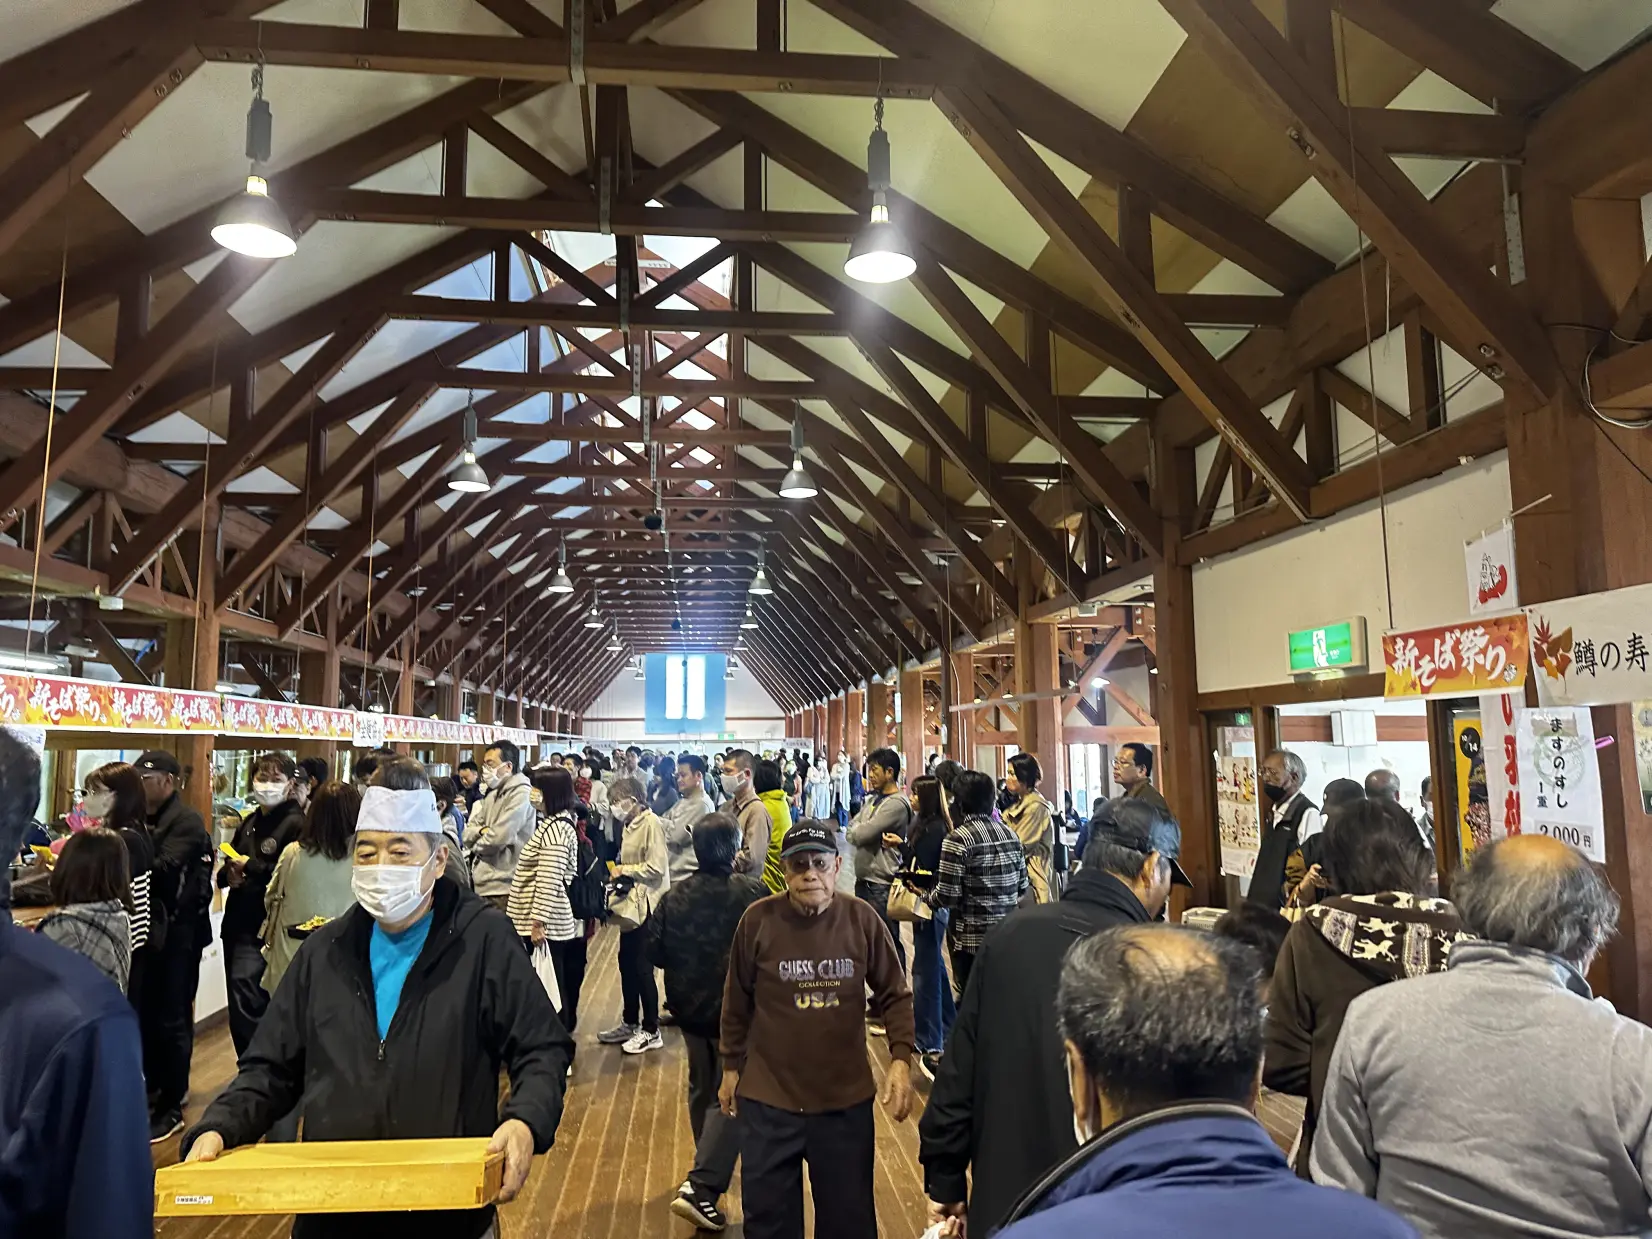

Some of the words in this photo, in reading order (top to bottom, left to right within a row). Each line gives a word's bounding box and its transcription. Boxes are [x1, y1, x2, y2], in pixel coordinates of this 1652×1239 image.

[1392, 625, 1506, 686] 新そば祭り
[1573, 631, 1650, 678] 鱒の寿
[29, 680, 100, 721] 新そば祭り
[112, 688, 163, 724] 新そば祭り
[171, 694, 216, 726] 新そば祭り
[1550, 717, 1568, 808] ますのすし
[779, 959, 815, 981] GUESS
[817, 958, 854, 979] CLUB
[798, 980, 841, 988] COLLECTION
[794, 991, 840, 1009] USA
